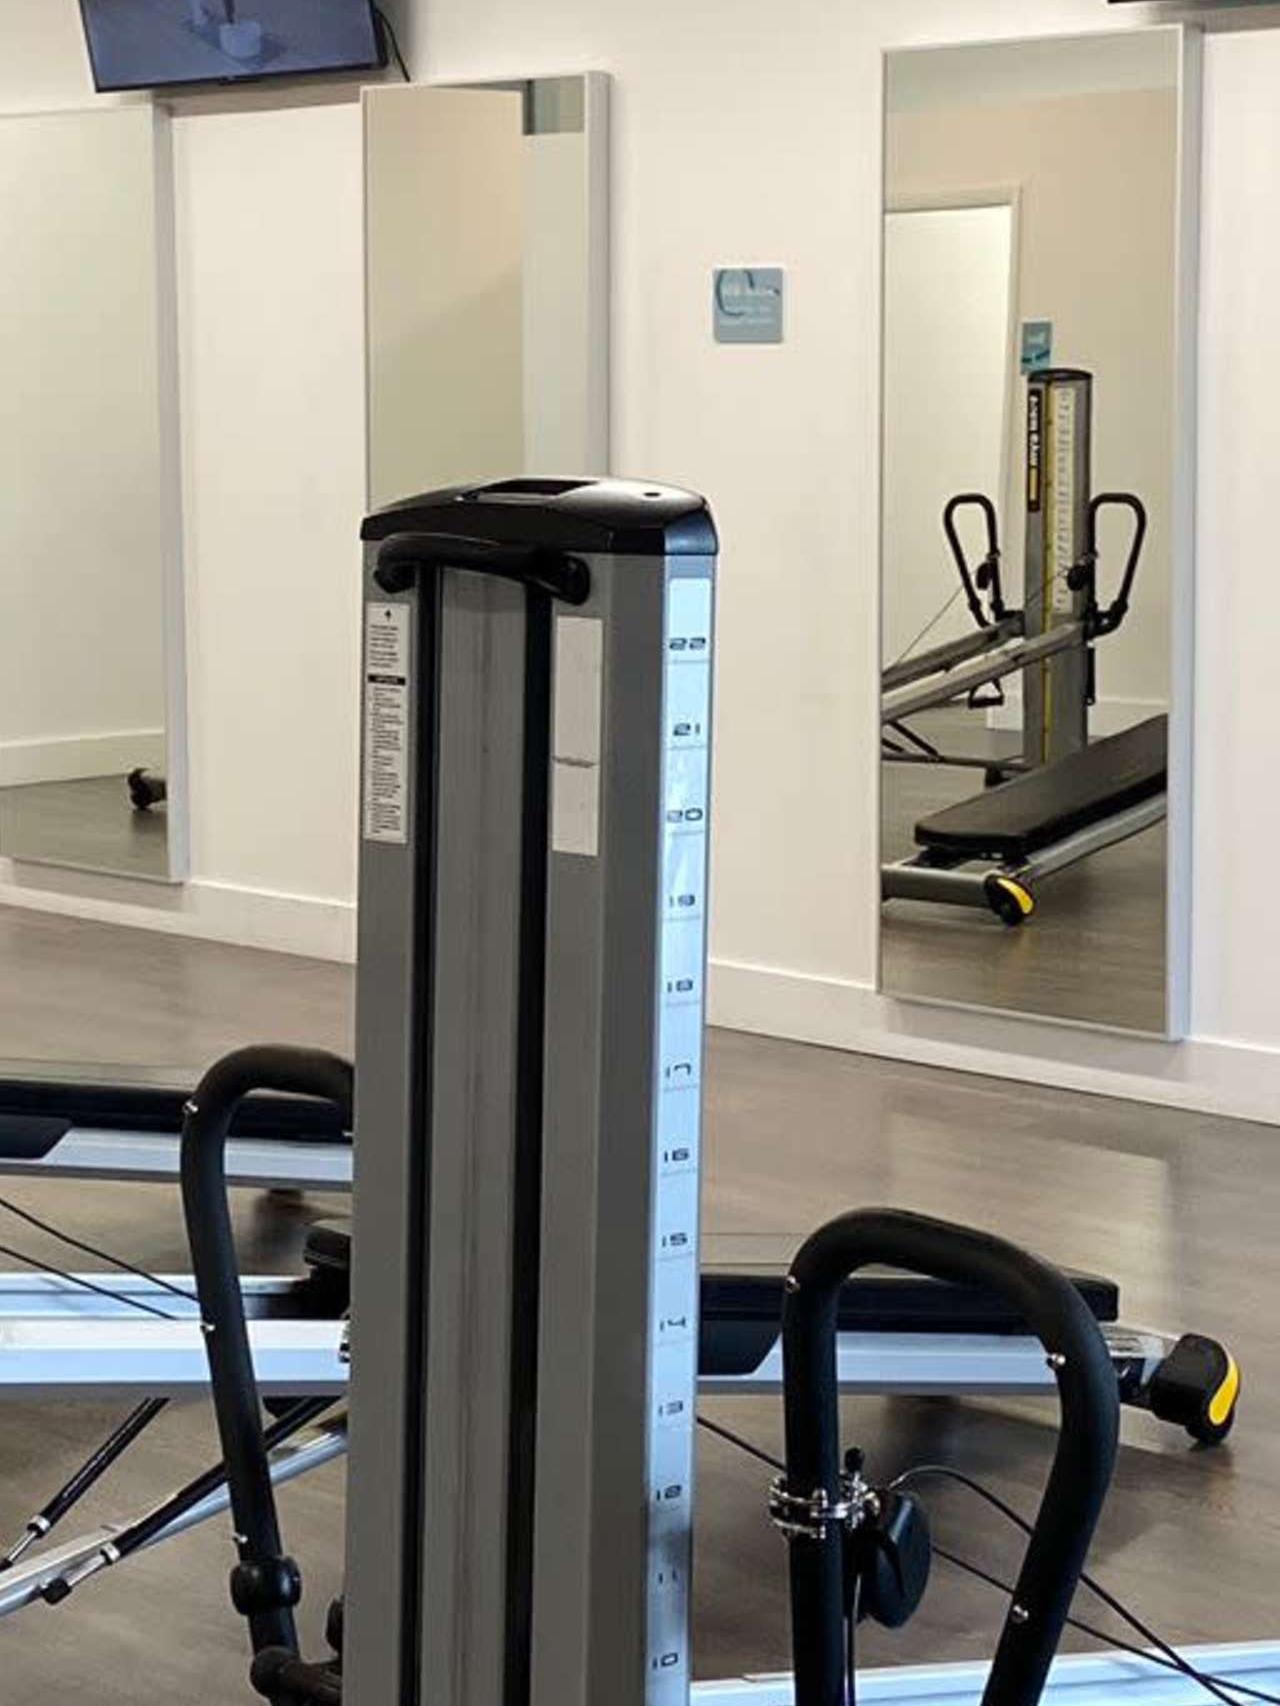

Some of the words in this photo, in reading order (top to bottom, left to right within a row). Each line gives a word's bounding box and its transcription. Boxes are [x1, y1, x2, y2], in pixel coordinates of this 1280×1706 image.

[669, 637, 706, 650] 22
[673, 723, 701, 736] 21
[668, 808, 703, 822] 20
[665, 1062, 691, 1078] 17
[652, 1653, 678, 1669] 10
